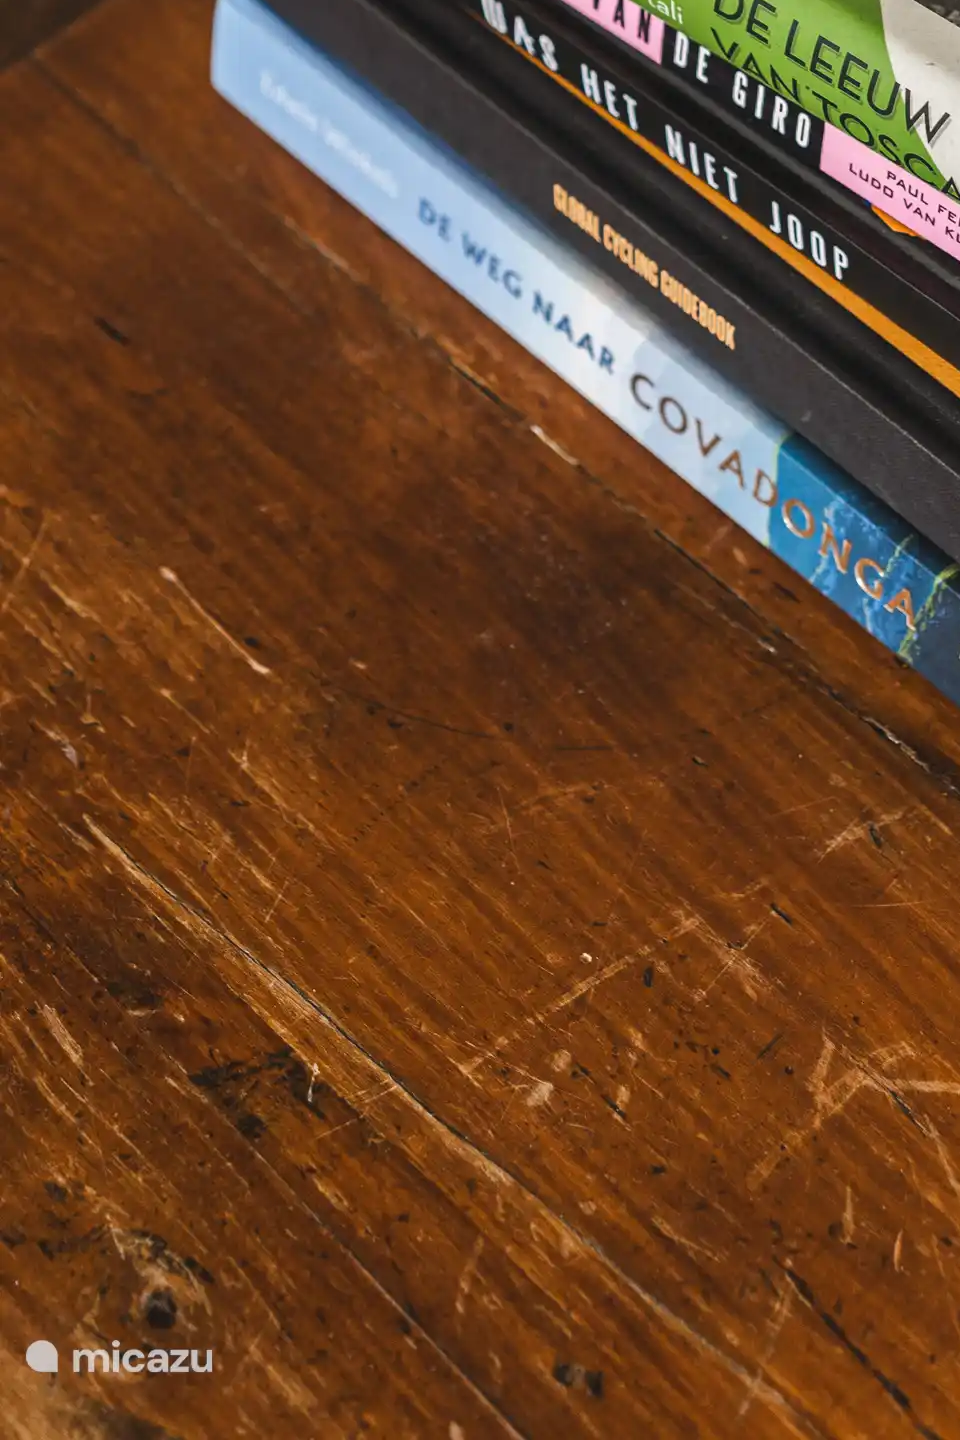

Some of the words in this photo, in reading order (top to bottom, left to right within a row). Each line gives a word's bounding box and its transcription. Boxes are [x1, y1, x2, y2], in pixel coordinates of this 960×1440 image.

[673, 30, 711, 84] DE
[731, 71, 812, 149] GIRO
[710, 27, 800, 101] VAN
[784, 19, 952, 146] LEEUW
[580, 63, 639, 131] HET
[664, 124, 739, 204] NIET
[769, 200, 850, 281] JOOP
[848, 162, 894, 199] LUDO
[903, 198, 936, 227] VAN
[886, 170, 929, 206] PAUL
[553, 183, 601, 244] GLOBAL
[602, 223, 659, 289] CYCLING
[660, 269, 736, 351] GUIDEBOOK
[416, 197, 454, 242] DE
[460, 230, 524, 300] WEG
[530, 289, 616, 375] NAAR
[630, 372, 917, 632] COVADONGA
